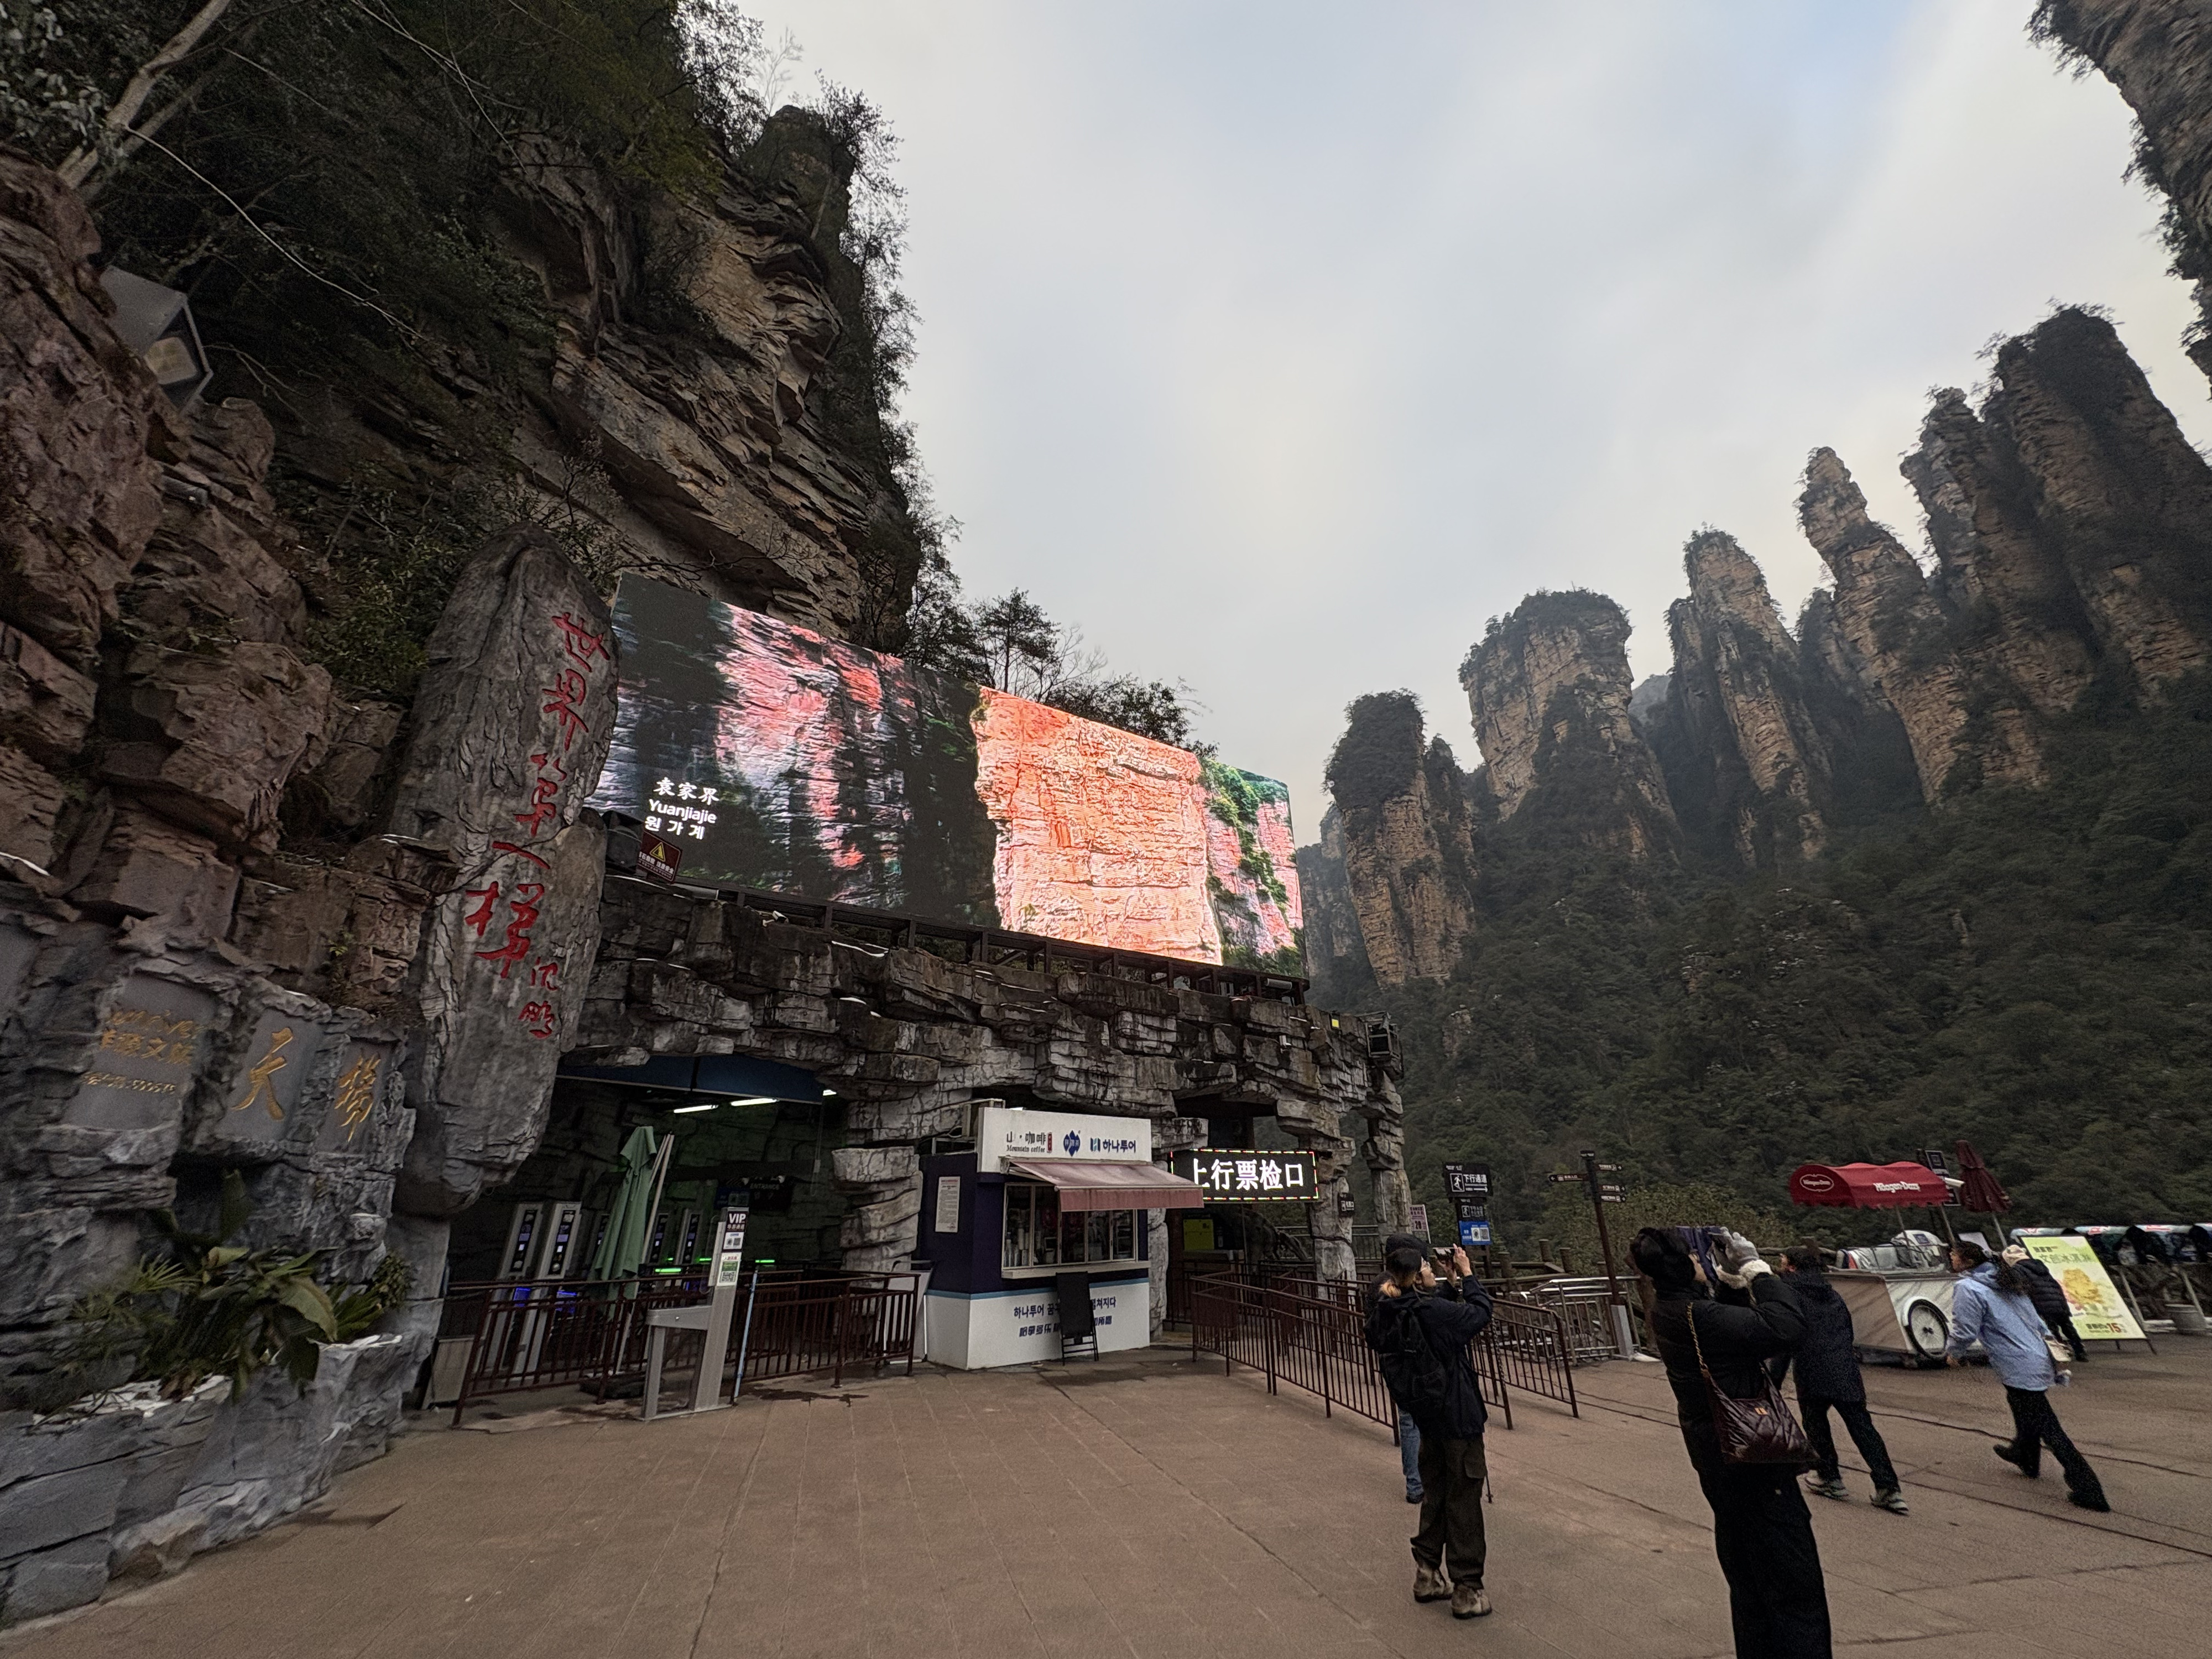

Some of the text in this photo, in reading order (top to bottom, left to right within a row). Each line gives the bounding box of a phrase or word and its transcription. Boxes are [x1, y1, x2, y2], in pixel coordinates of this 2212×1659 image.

[653, 777, 719, 805] 袁家界
[649, 799, 717, 824] Yuanjiajie
[1103, 1139, 1136, 1153] 하나투어
[1193, 1158, 1303, 1191] 上行票检口
[1463, 1174, 1488, 1183] 下行通道
[729, 1213, 746, 1224] VIP
[1415, 1220, 1422, 1229] 20
[1014, 1303, 1045, 1319] 하나투어
[2106, 1323, 2122, 1333] 15
